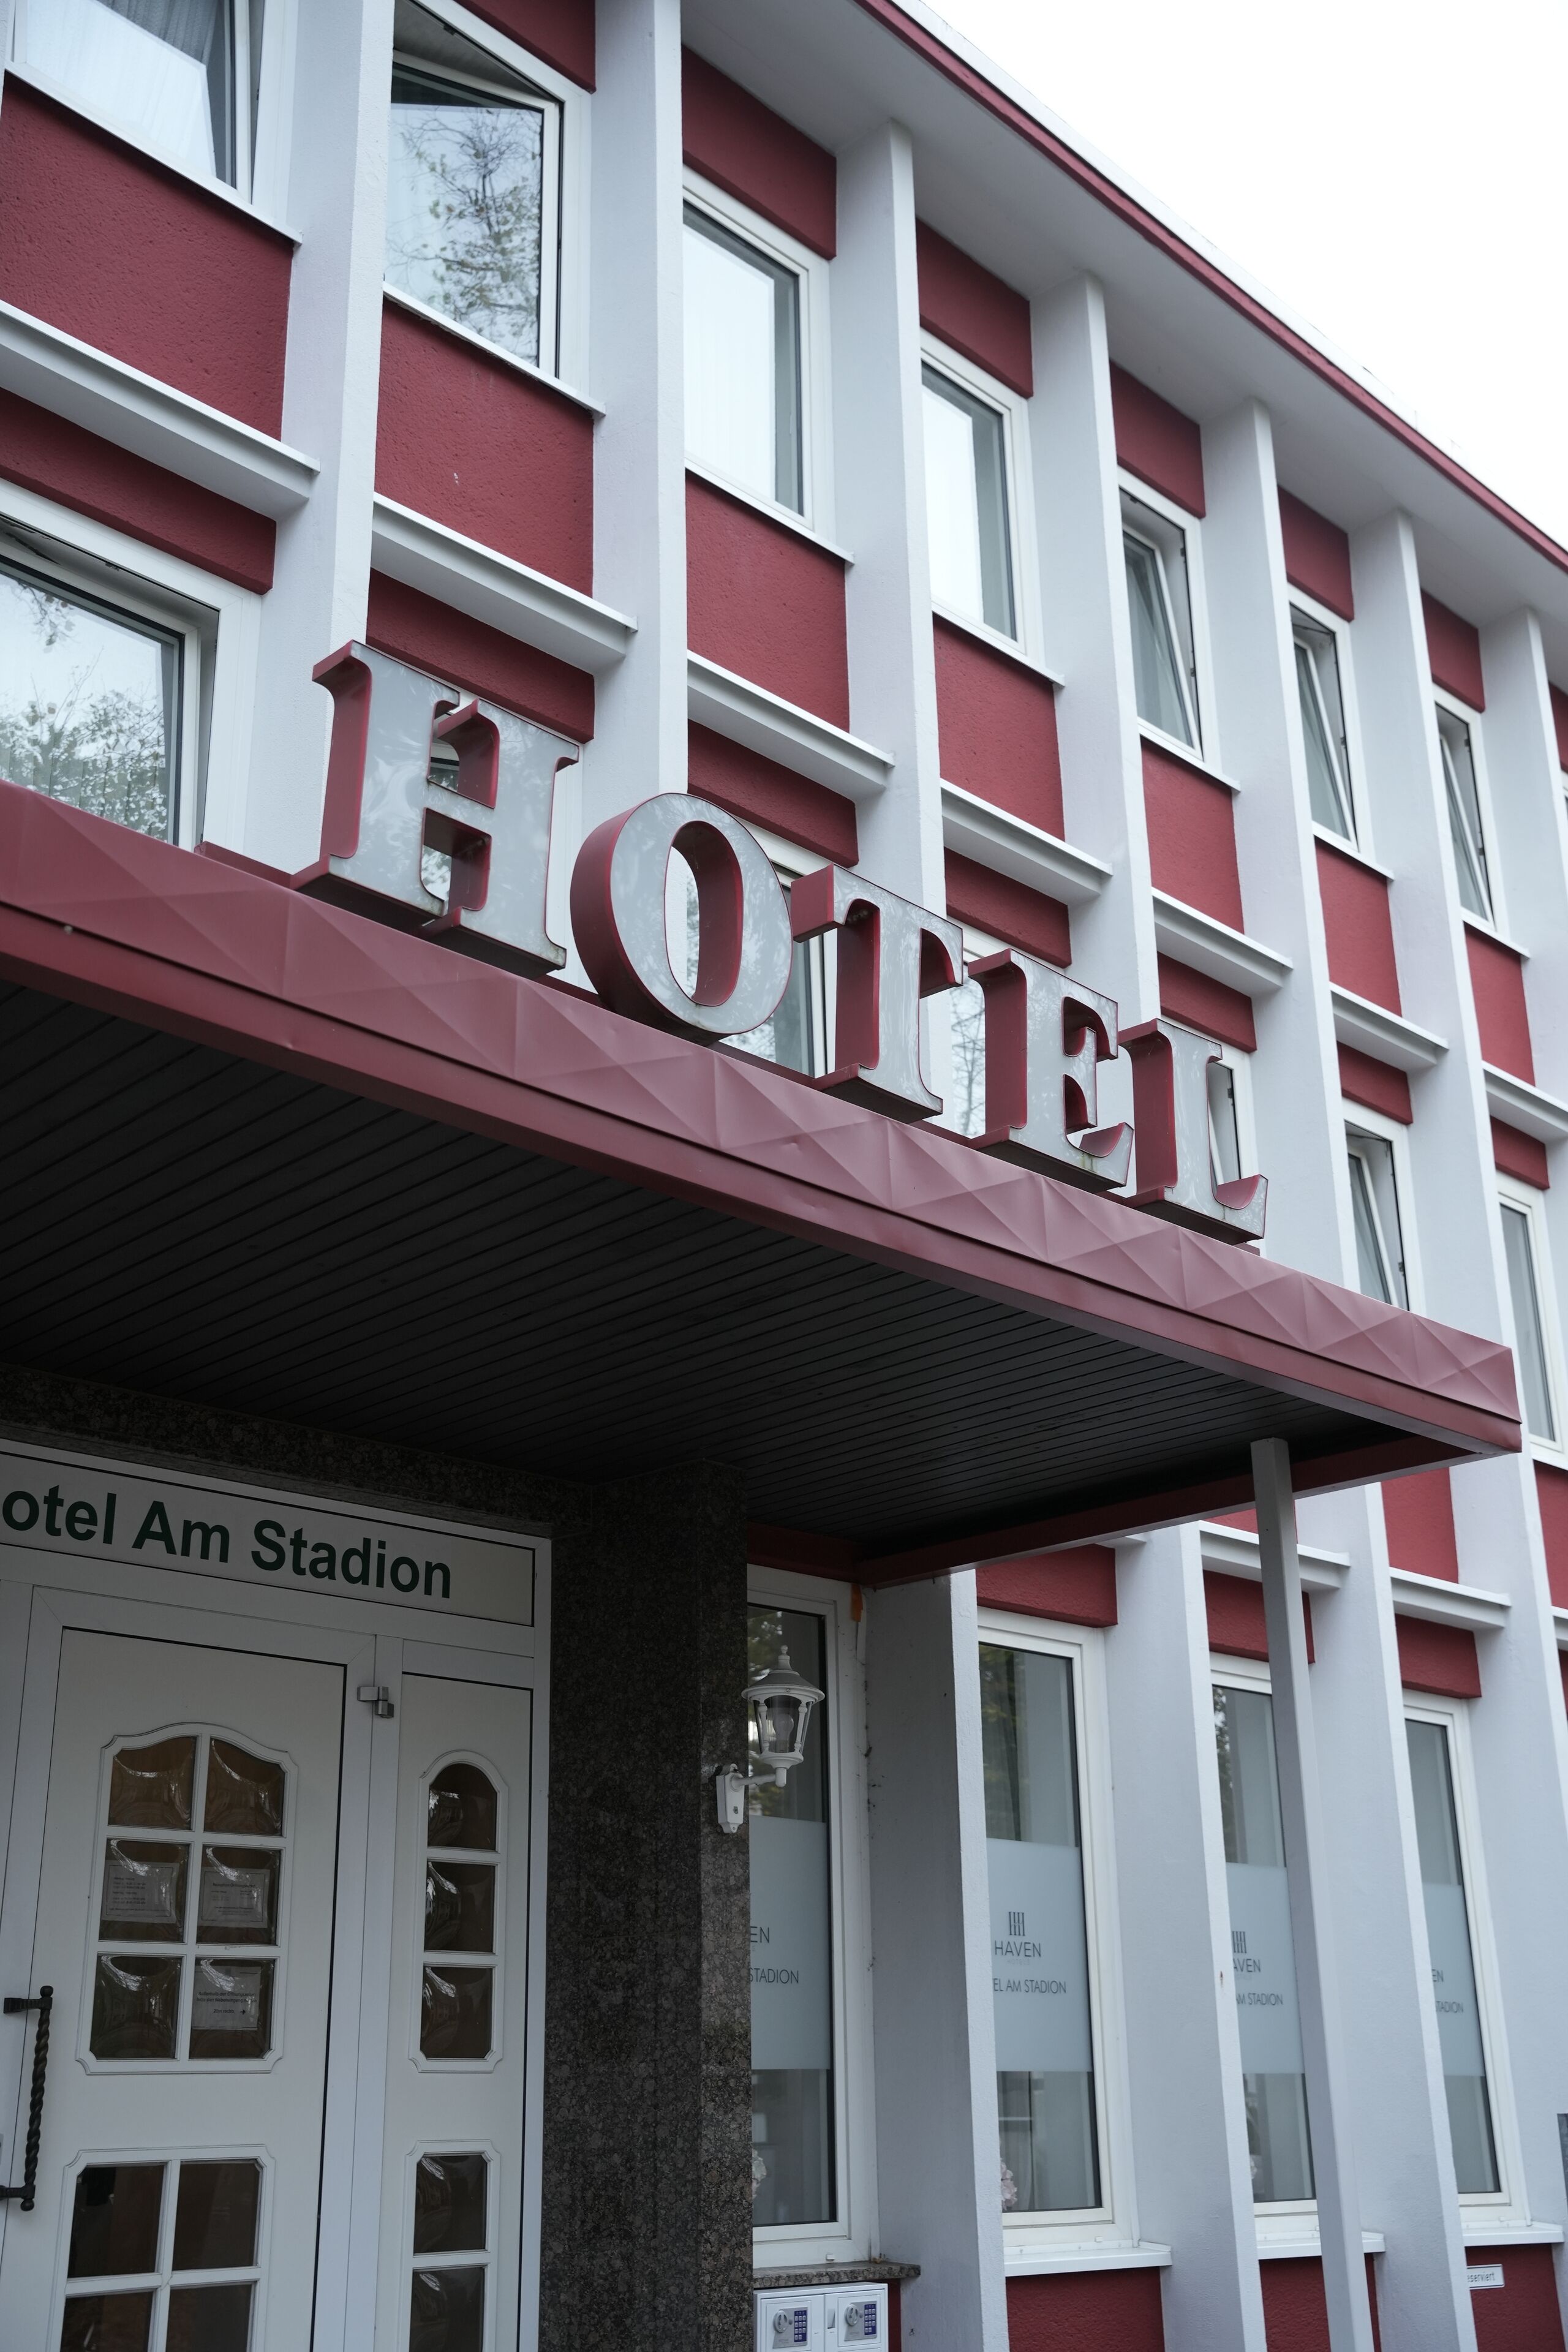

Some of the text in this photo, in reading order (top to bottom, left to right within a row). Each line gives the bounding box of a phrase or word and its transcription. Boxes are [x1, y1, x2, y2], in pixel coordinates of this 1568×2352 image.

[294, 641, 1268, 1245] HOTEL
[2, 1485, 451, 1599] otel Am Stadion
[750, 1926, 770, 1943] EN
[994, 1940, 1041, 1958] HAVEN
[1232, 1958, 1261, 1973] AVEN
[992, 1978, 1067, 1994] EL AM STADION
[1248, 1993, 1284, 2006] STADION
[1435, 2000, 1464, 2013] TADION
